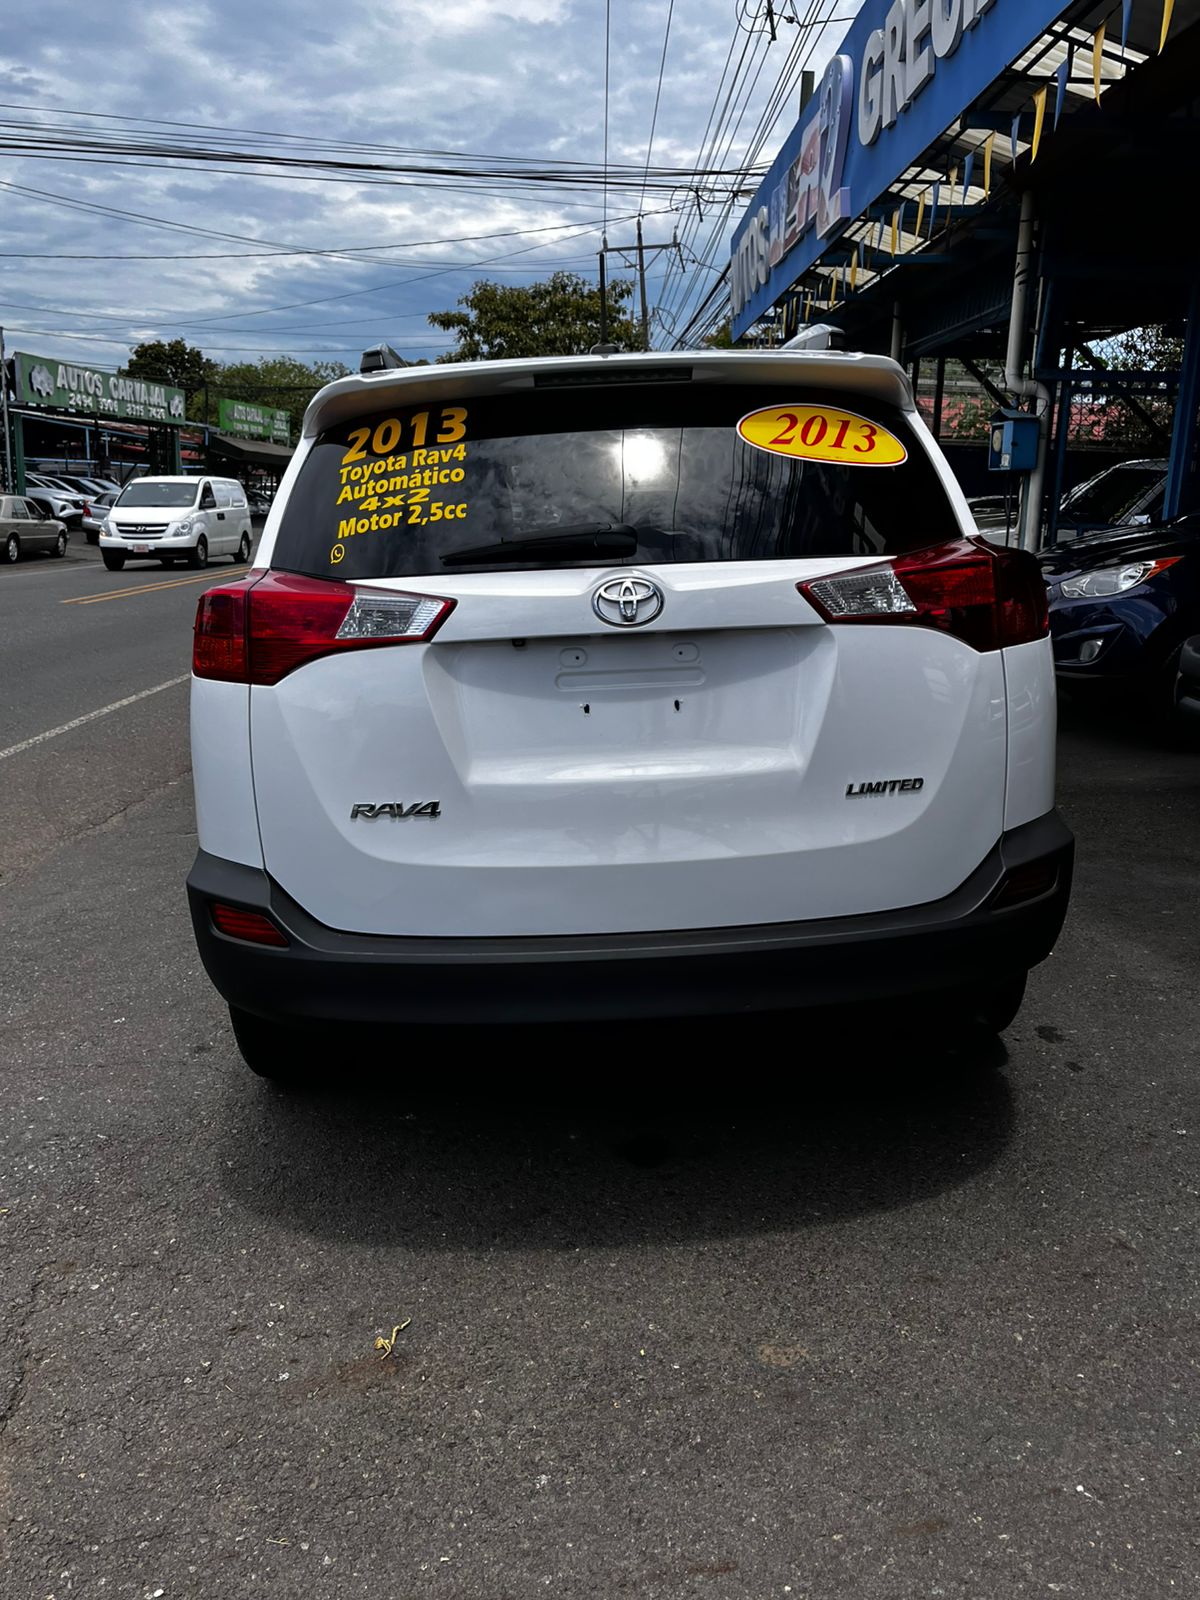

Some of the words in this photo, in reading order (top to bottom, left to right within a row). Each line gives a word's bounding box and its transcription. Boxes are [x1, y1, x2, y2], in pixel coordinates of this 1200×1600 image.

[731, 205, 769, 319] AUTOS
[56, 364, 104, 397] AUTOS
[109, 376, 169, 408] CARVAJAL
[341, 407, 468, 465] 2013
[768, 413, 878, 453] 2013
[340, 455, 407, 484] Toyota
[412, 443, 467, 467] Rav4
[336, 466, 465, 505] Automático
[358, 488, 431, 511] 4x2
[337, 511, 403, 539] Motor
[407, 502, 468, 526] 2,5cc
[845, 777, 924, 797] LIMITED
[350, 799, 442, 820] RAV4
